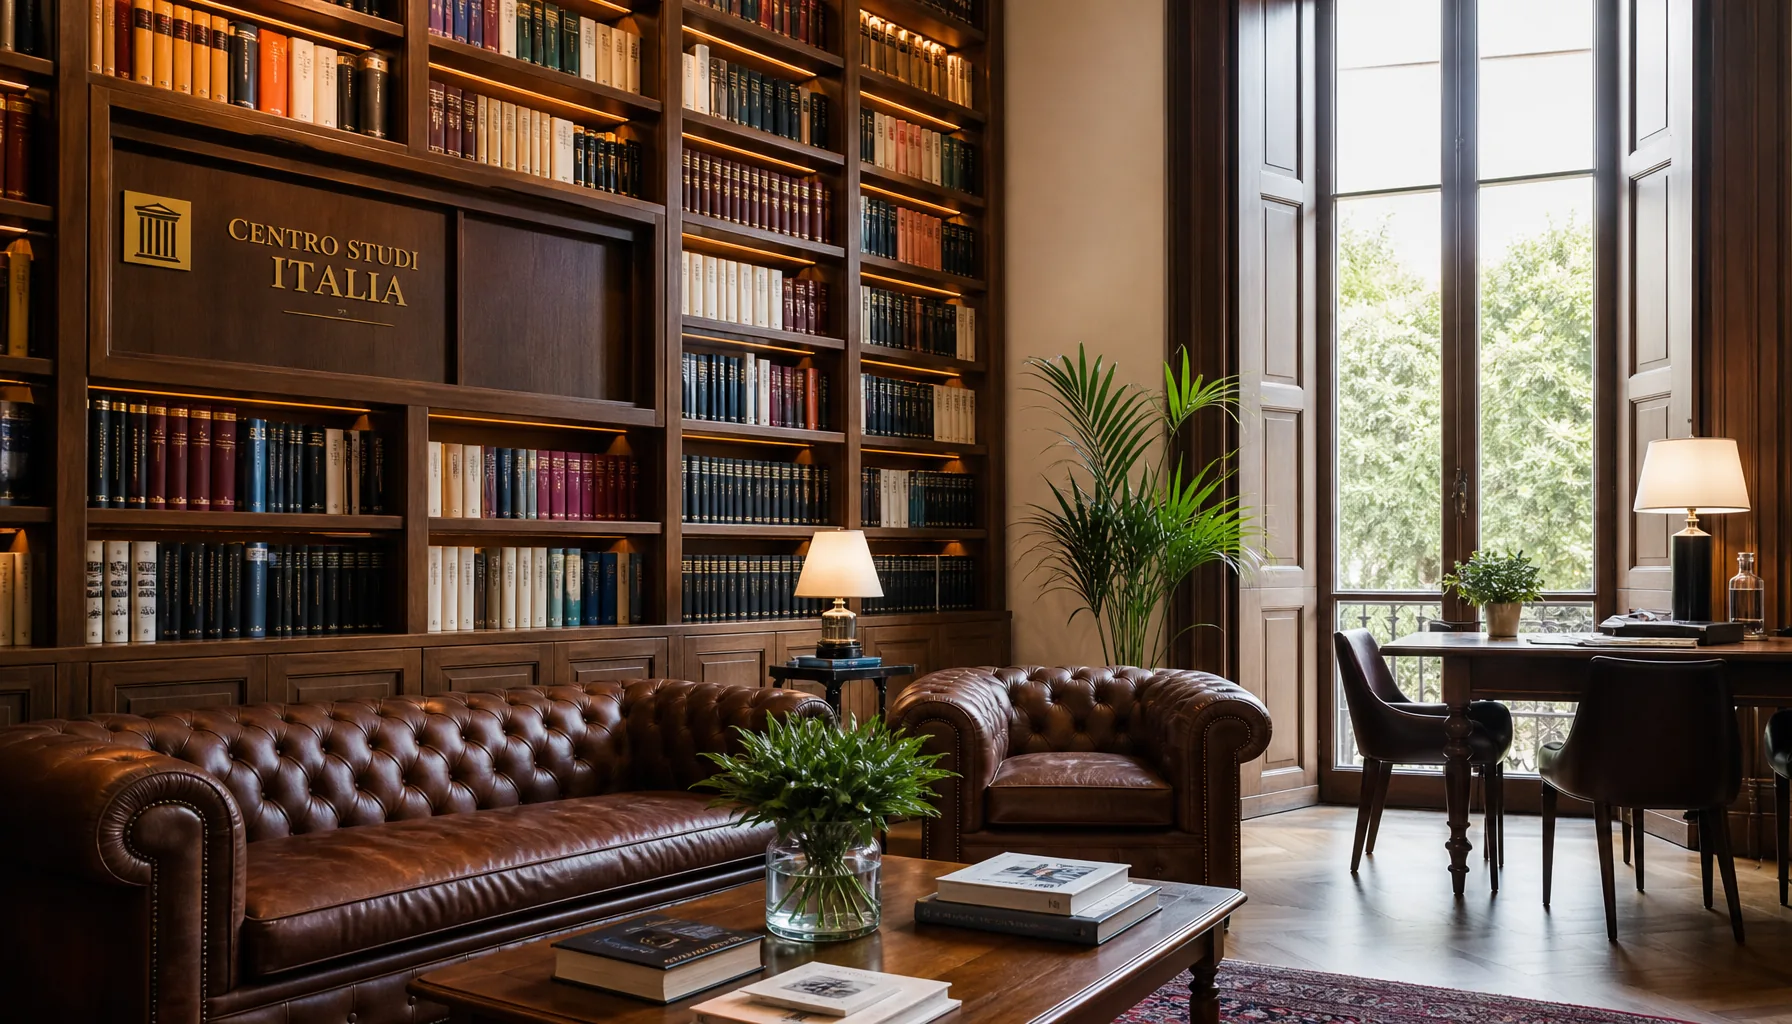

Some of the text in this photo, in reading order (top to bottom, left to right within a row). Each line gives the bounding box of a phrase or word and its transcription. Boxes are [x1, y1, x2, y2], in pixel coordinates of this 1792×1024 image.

[228, 218, 419, 271] CENTRO STUDI
[271, 256, 408, 307] ITALIA
